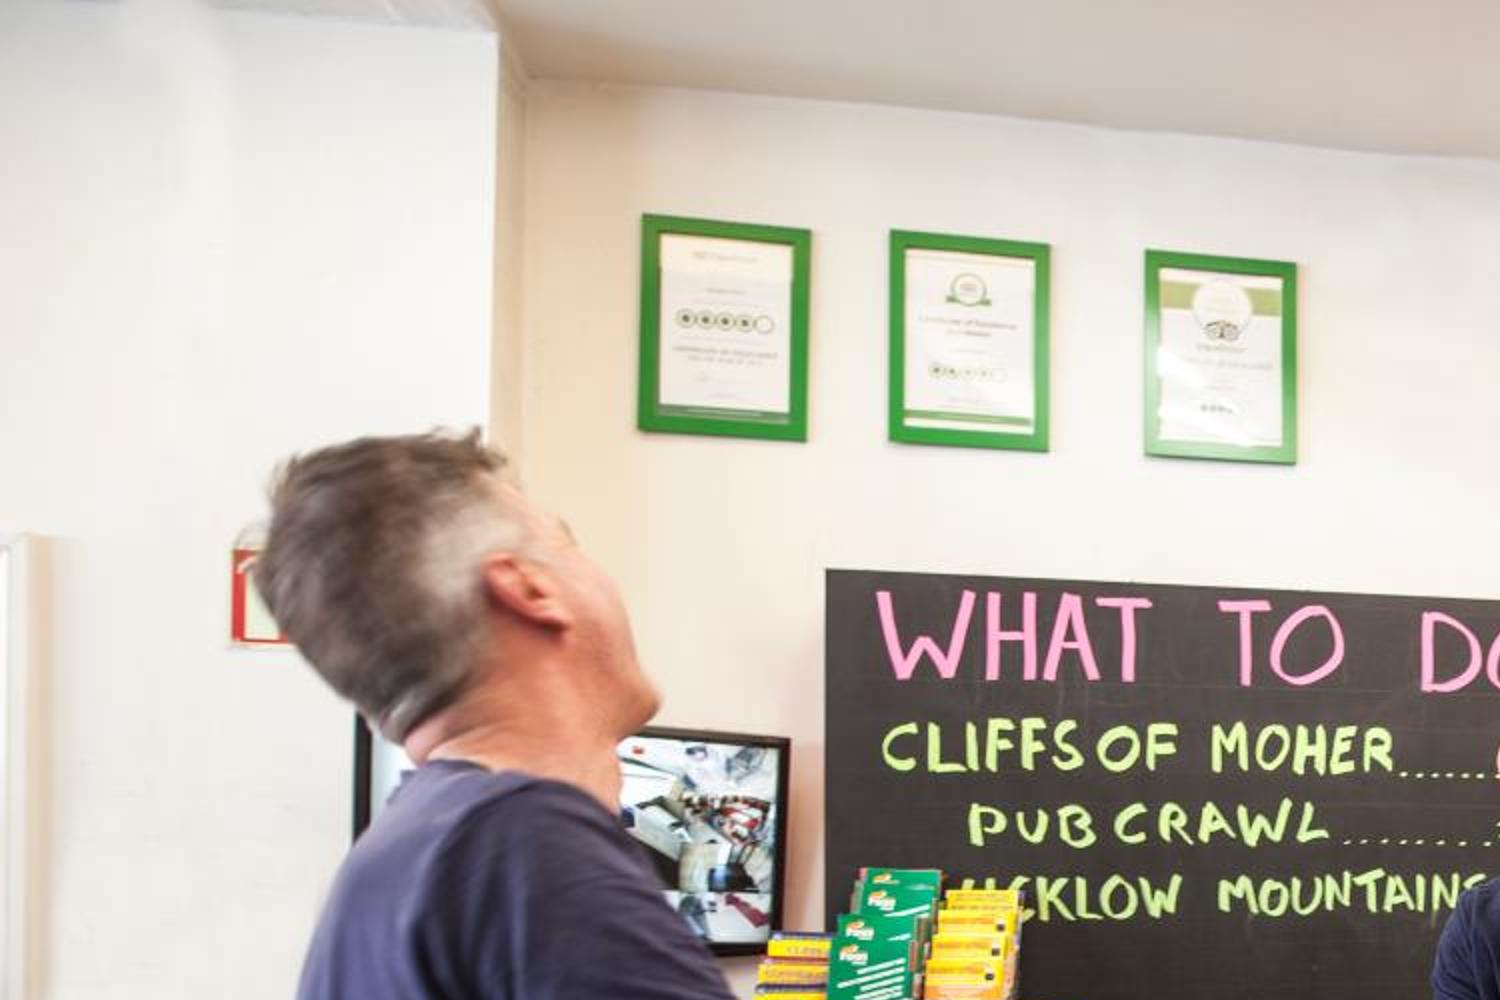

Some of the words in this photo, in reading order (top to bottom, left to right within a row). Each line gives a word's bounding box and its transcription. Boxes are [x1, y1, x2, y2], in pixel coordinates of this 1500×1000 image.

[876, 590, 1153, 683] WHAT
[1217, 600, 1345, 687] TO
[882, 717, 1084, 773] CLIFFS
[1096, 722, 1178, 773] OF
[1210, 721, 1393, 776] MOHER
[968, 802, 1097, 849] PUB
[1113, 797, 1330, 847] CRAWL
[961, 873, 1183, 922] CKLOW
